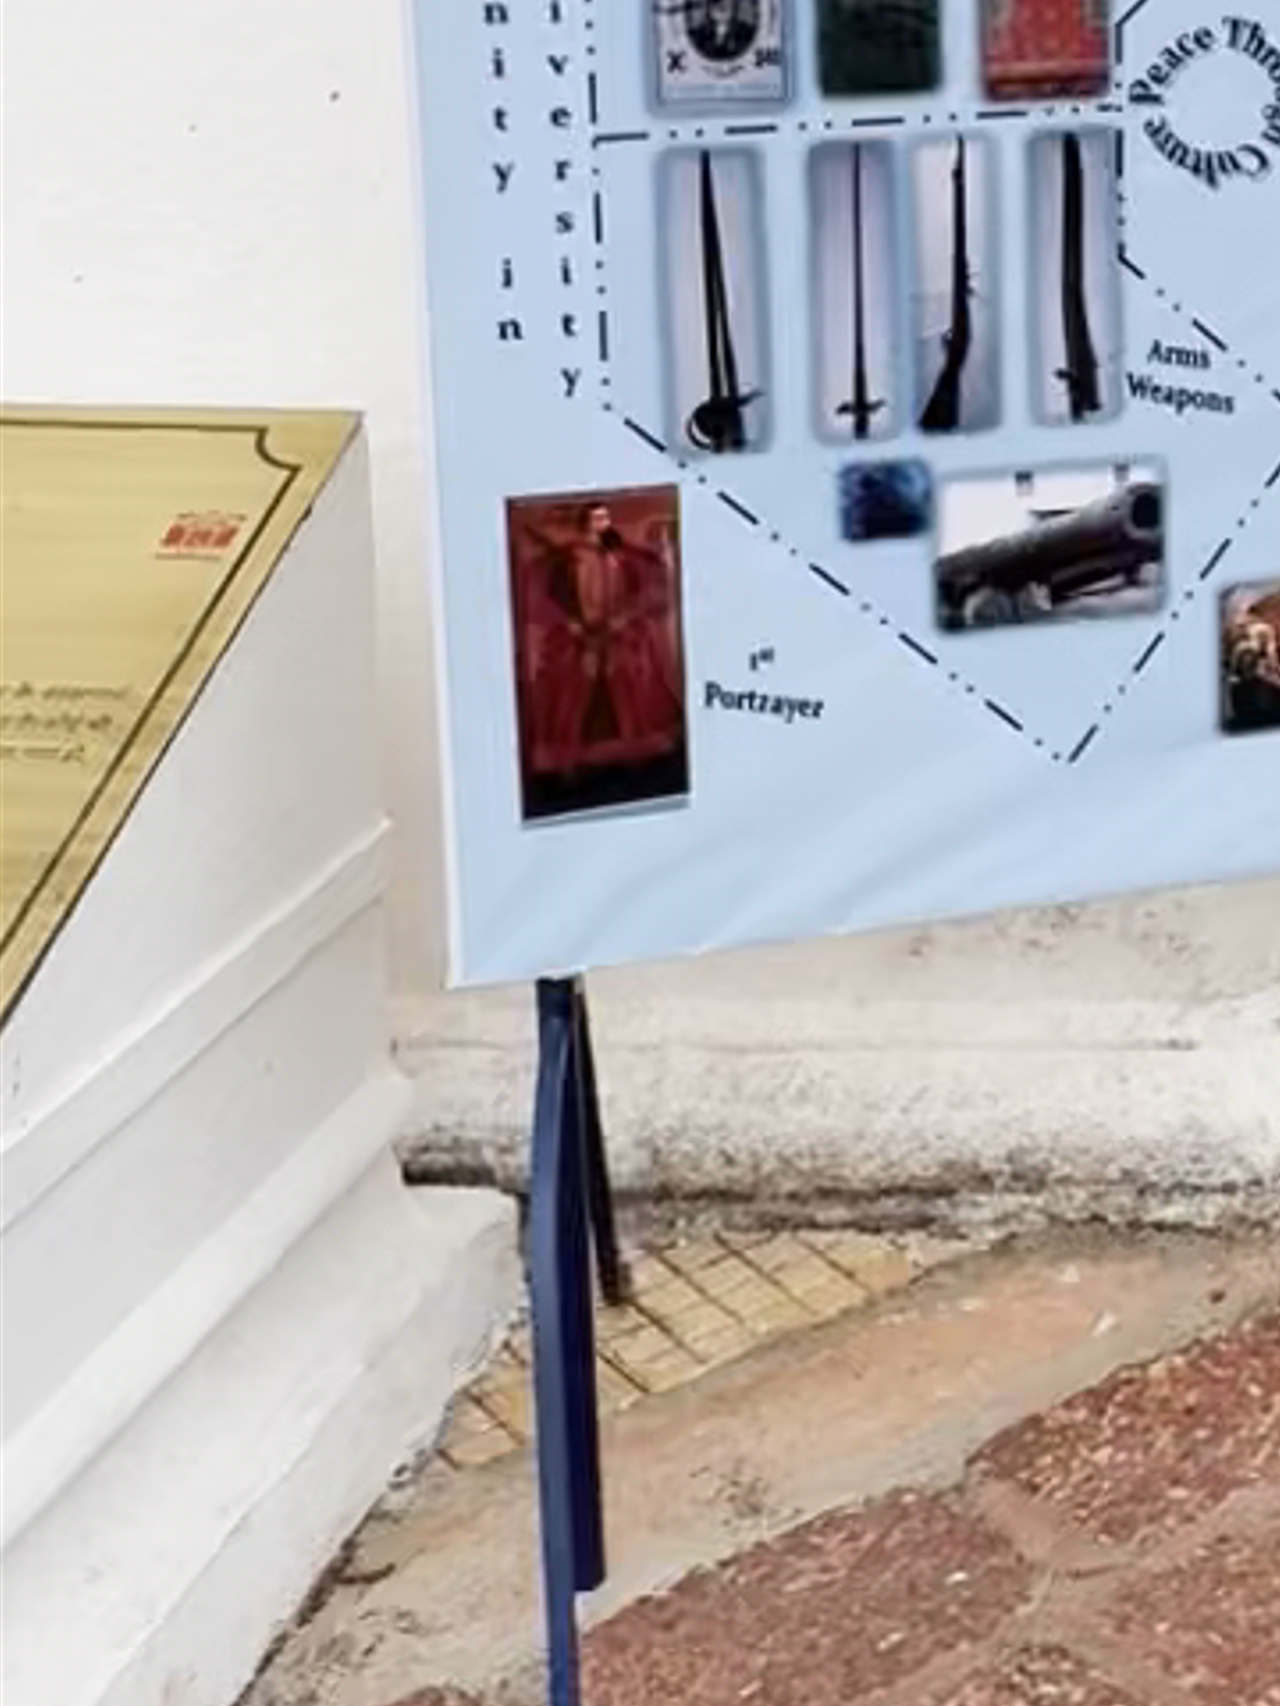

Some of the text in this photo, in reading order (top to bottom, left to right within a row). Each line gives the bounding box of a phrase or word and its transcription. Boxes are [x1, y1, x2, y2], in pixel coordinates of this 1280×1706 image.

[1128, 27, 1214, 105] Peace
[1142, 116, 1271, 192] Culture
[1146, 339, 1211, 369] Arms
[1126, 372, 1235, 416] Weapons
